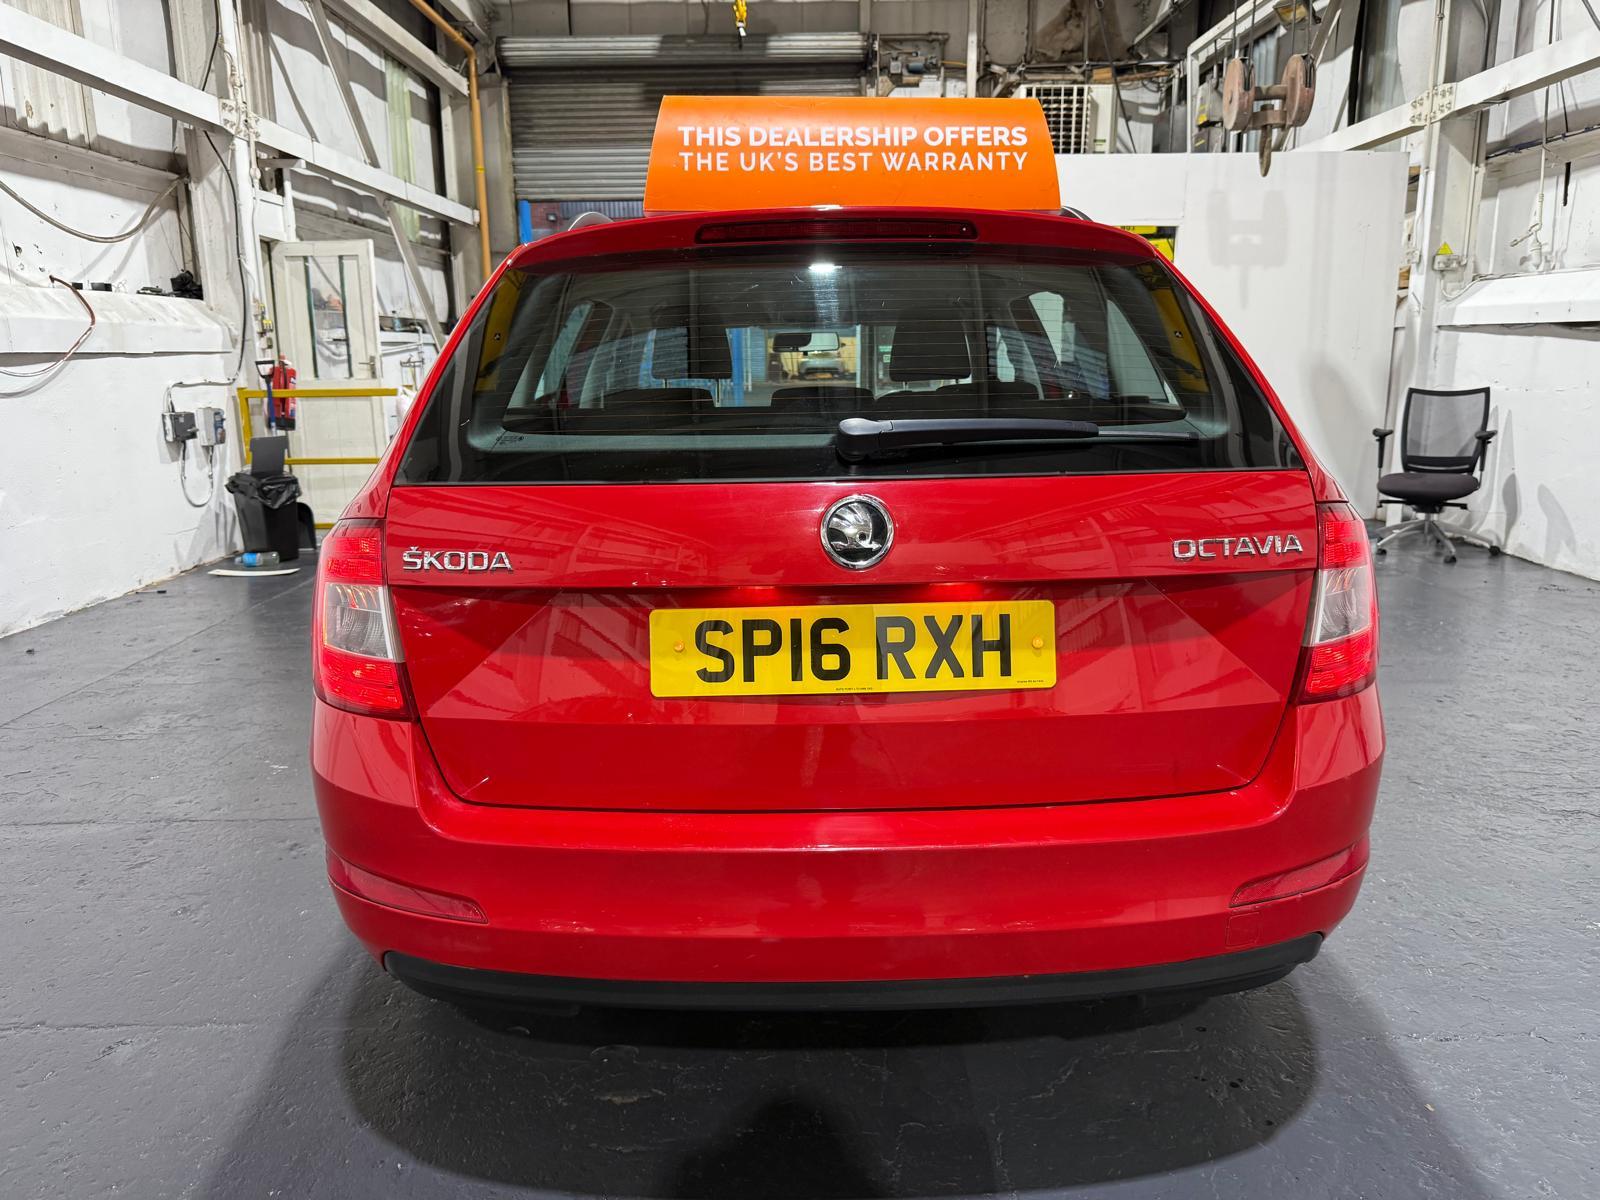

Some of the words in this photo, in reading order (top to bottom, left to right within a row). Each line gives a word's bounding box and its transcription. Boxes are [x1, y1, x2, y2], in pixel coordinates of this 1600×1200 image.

[678, 125, 741, 147] THIS
[748, 125, 917, 147] DEALERSHIP
[923, 126, 1028, 147] OFFERS
[679, 151, 729, 171] THE
[739, 151, 799, 171] UK'S
[809, 151, 873, 171] BEST
[881, 151, 1029, 171] WARRANTY
[402, 546, 513, 571] ŠKODA
[1173, 534, 1303, 559] OCTAVIA
[694, 617, 851, 683] SP16
[875, 612, 1012, 680] RXH
